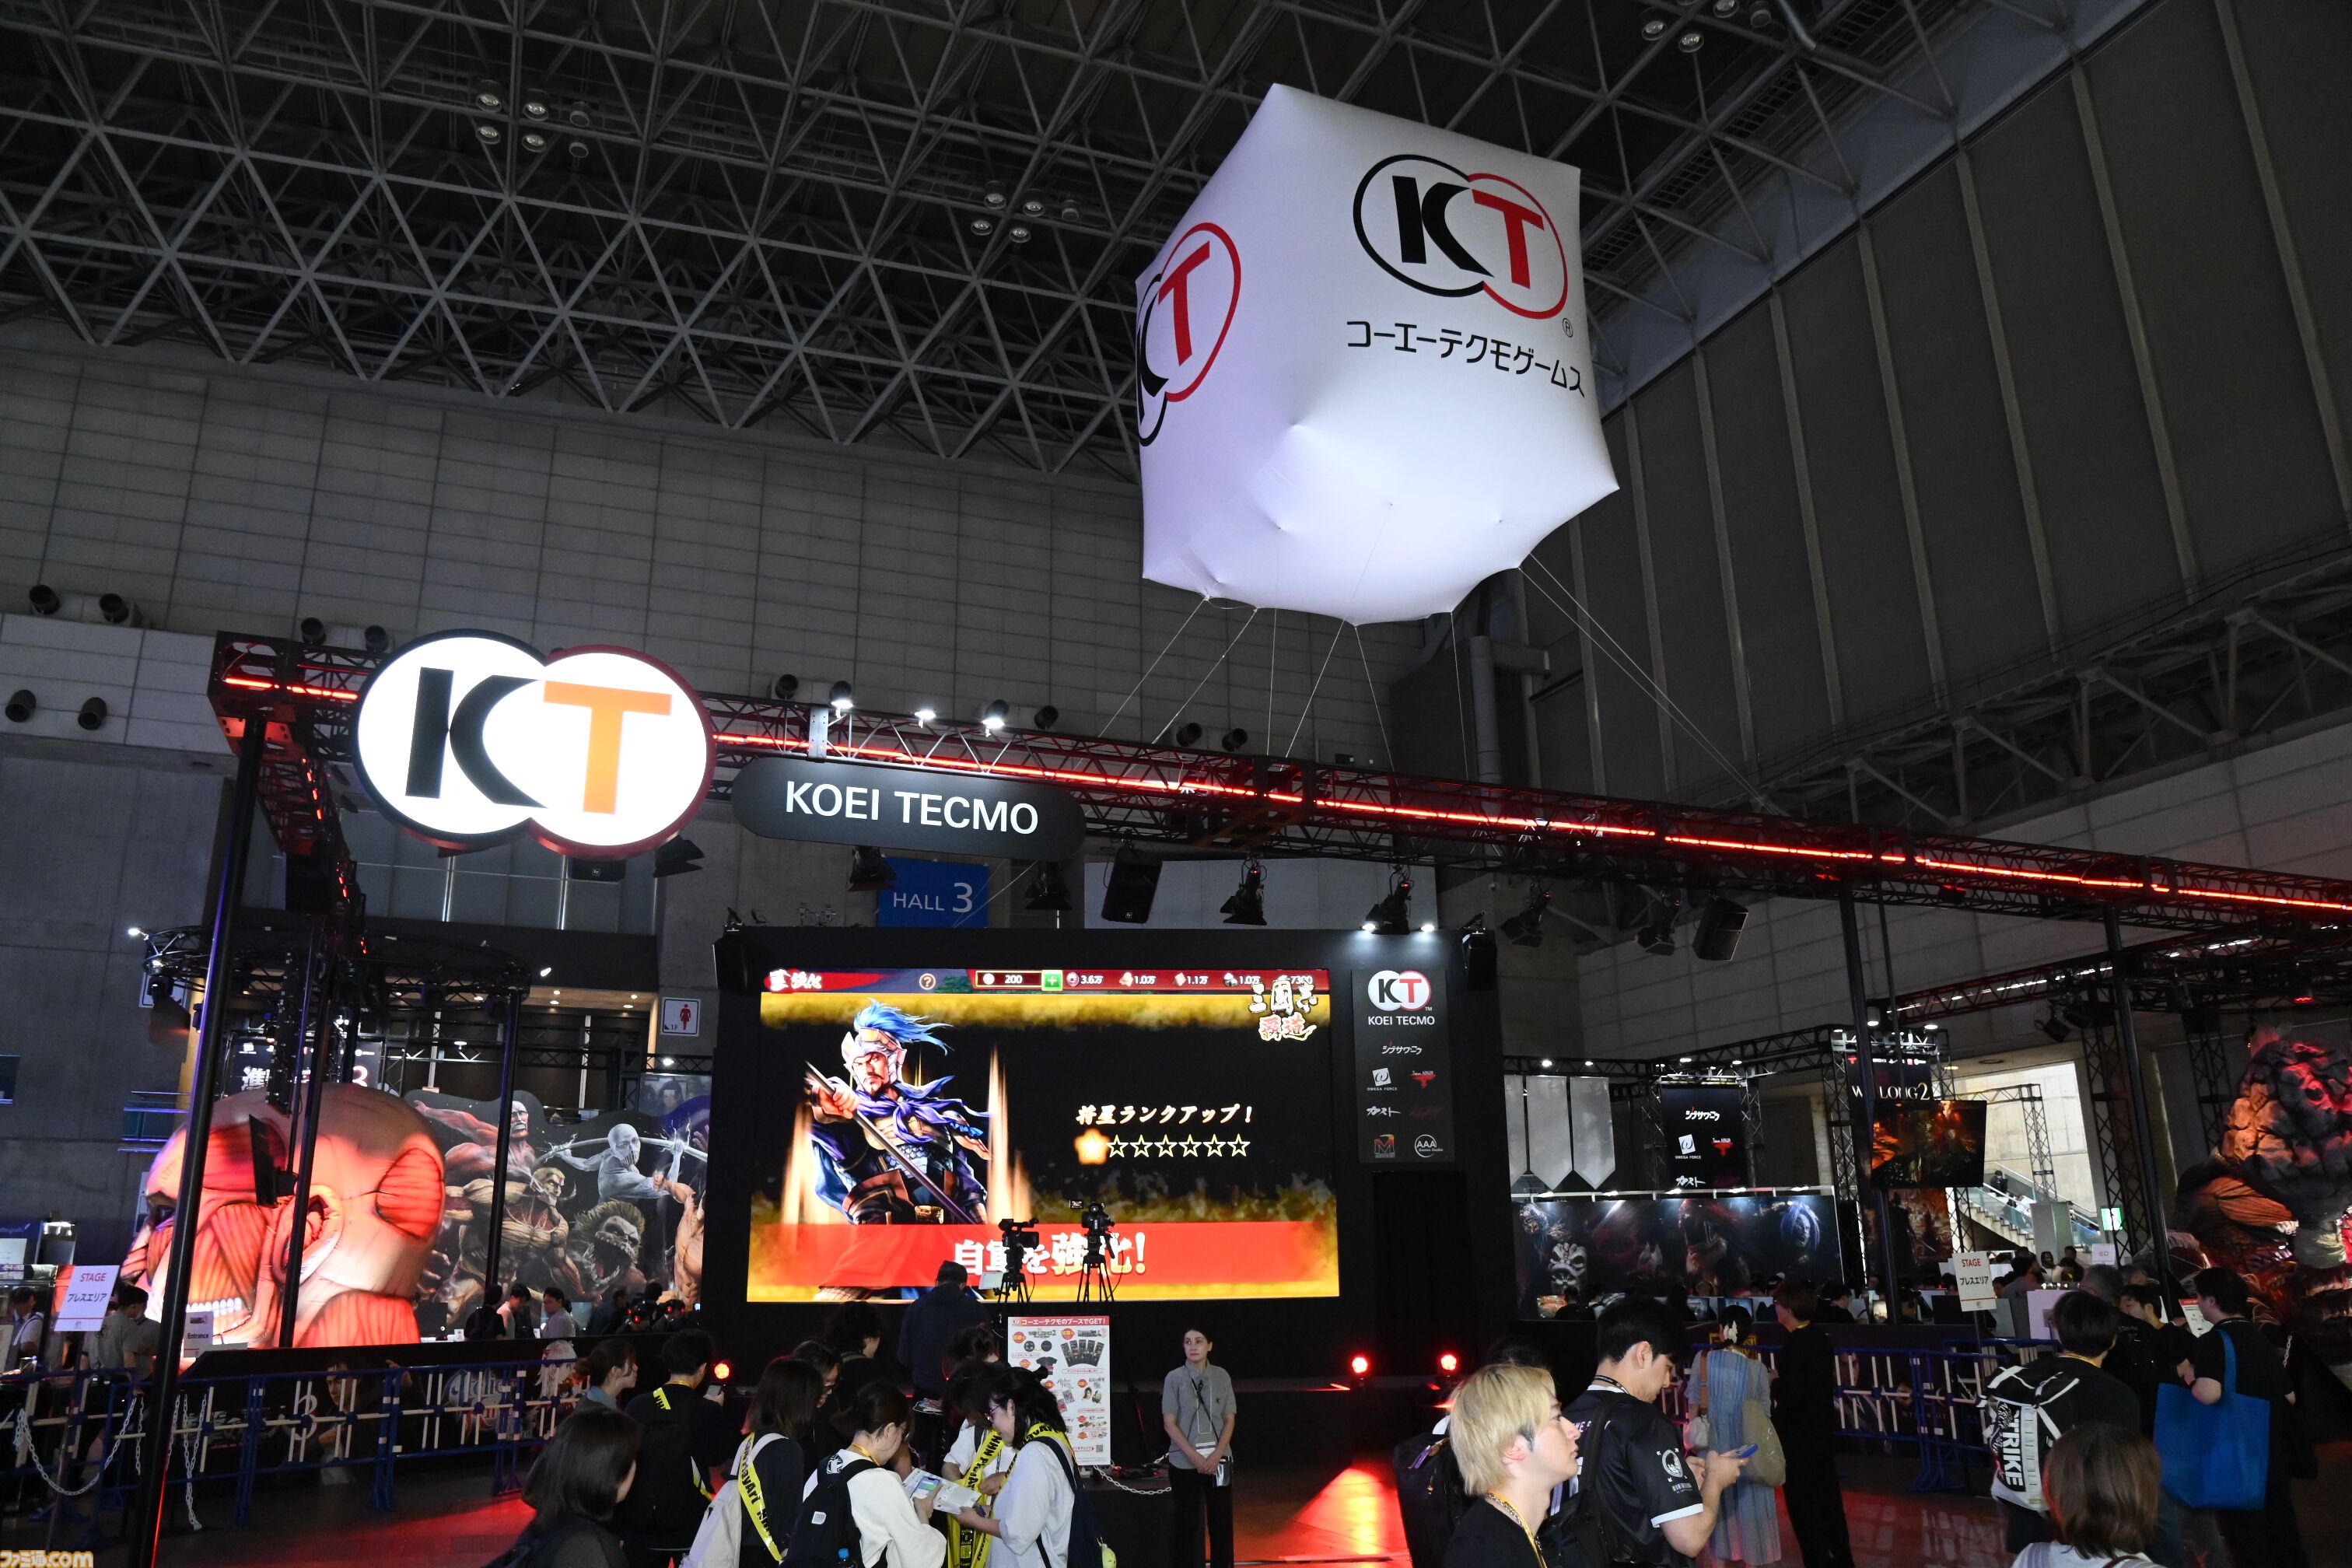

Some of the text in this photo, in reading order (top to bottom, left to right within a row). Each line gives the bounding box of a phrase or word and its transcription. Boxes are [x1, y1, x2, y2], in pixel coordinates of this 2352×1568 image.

[1391, 175, 1545, 289] KT
[1346, 320, 1585, 398] コーエーテクモゲームス
[404, 666, 673, 815] KT
[786, 780, 1039, 835] KOEI TECMO
[893, 882, 974, 913] HALL 3
[1004, 975, 1024, 985] 200
[1080, 975, 1103, 985] 3.6万
[1134, 975, 1157, 985] 1.0万
[1187, 975, 1209, 985] 1.1万
[1377, 978, 1423, 1004] KT
[1259, 1012, 1318, 1041] 覇道
[1368, 1016, 1435, 1025] KOEI TECMO
[1366, 1105, 1402, 1118] ガスト
[1416, 1140, 1437, 1149] AAA
[1676, 1175, 1706, 1188] ガスト
[1961, 1258, 1982, 1268] STAGE
[79, 1272, 107, 1283] STAGE
[1959, 1276, 1990, 1286] プレスエリア
[67, 1293, 107, 1303] プレスエリア
[983, 1434, 1003, 1461] NHN
